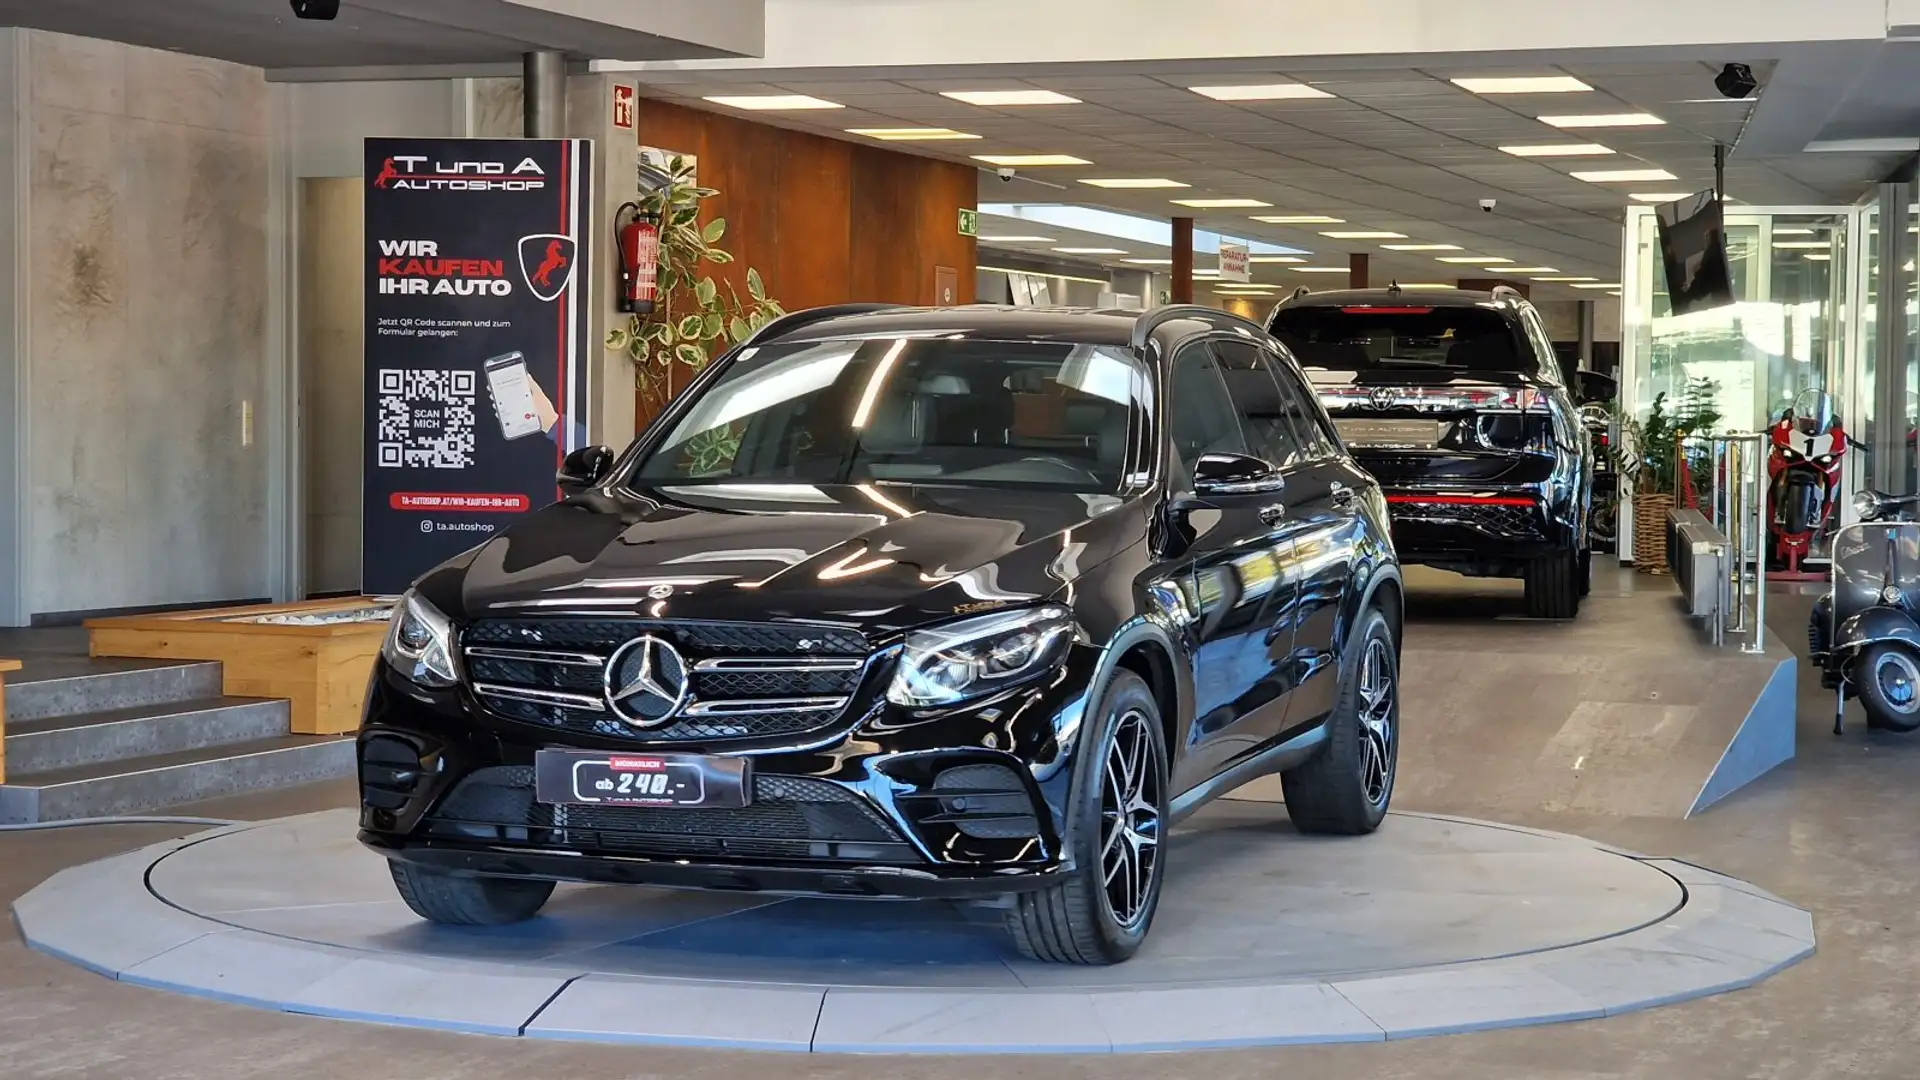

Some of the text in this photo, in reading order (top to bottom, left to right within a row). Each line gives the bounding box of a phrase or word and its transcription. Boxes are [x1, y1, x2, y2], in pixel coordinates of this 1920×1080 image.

[393, 156, 428, 173] T
[511, 157, 545, 175] A
[393, 179, 545, 191] AUTOSHOP
[379, 240, 438, 256] WIR
[379, 259, 503, 277] KAUFEN
[379, 278, 512, 296] IHR AUTO
[378, 318, 512, 328] Jetzt QR Code scannen und zum
[378, 327, 459, 338] Formular gelangen:
[414, 409, 441, 418] SCAN
[413, 419, 441, 429] MICH
[1804, 439, 1815, 457] 1
[436, 522, 495, 533] ta.autoshop
[595, 777, 615, 791] ab
